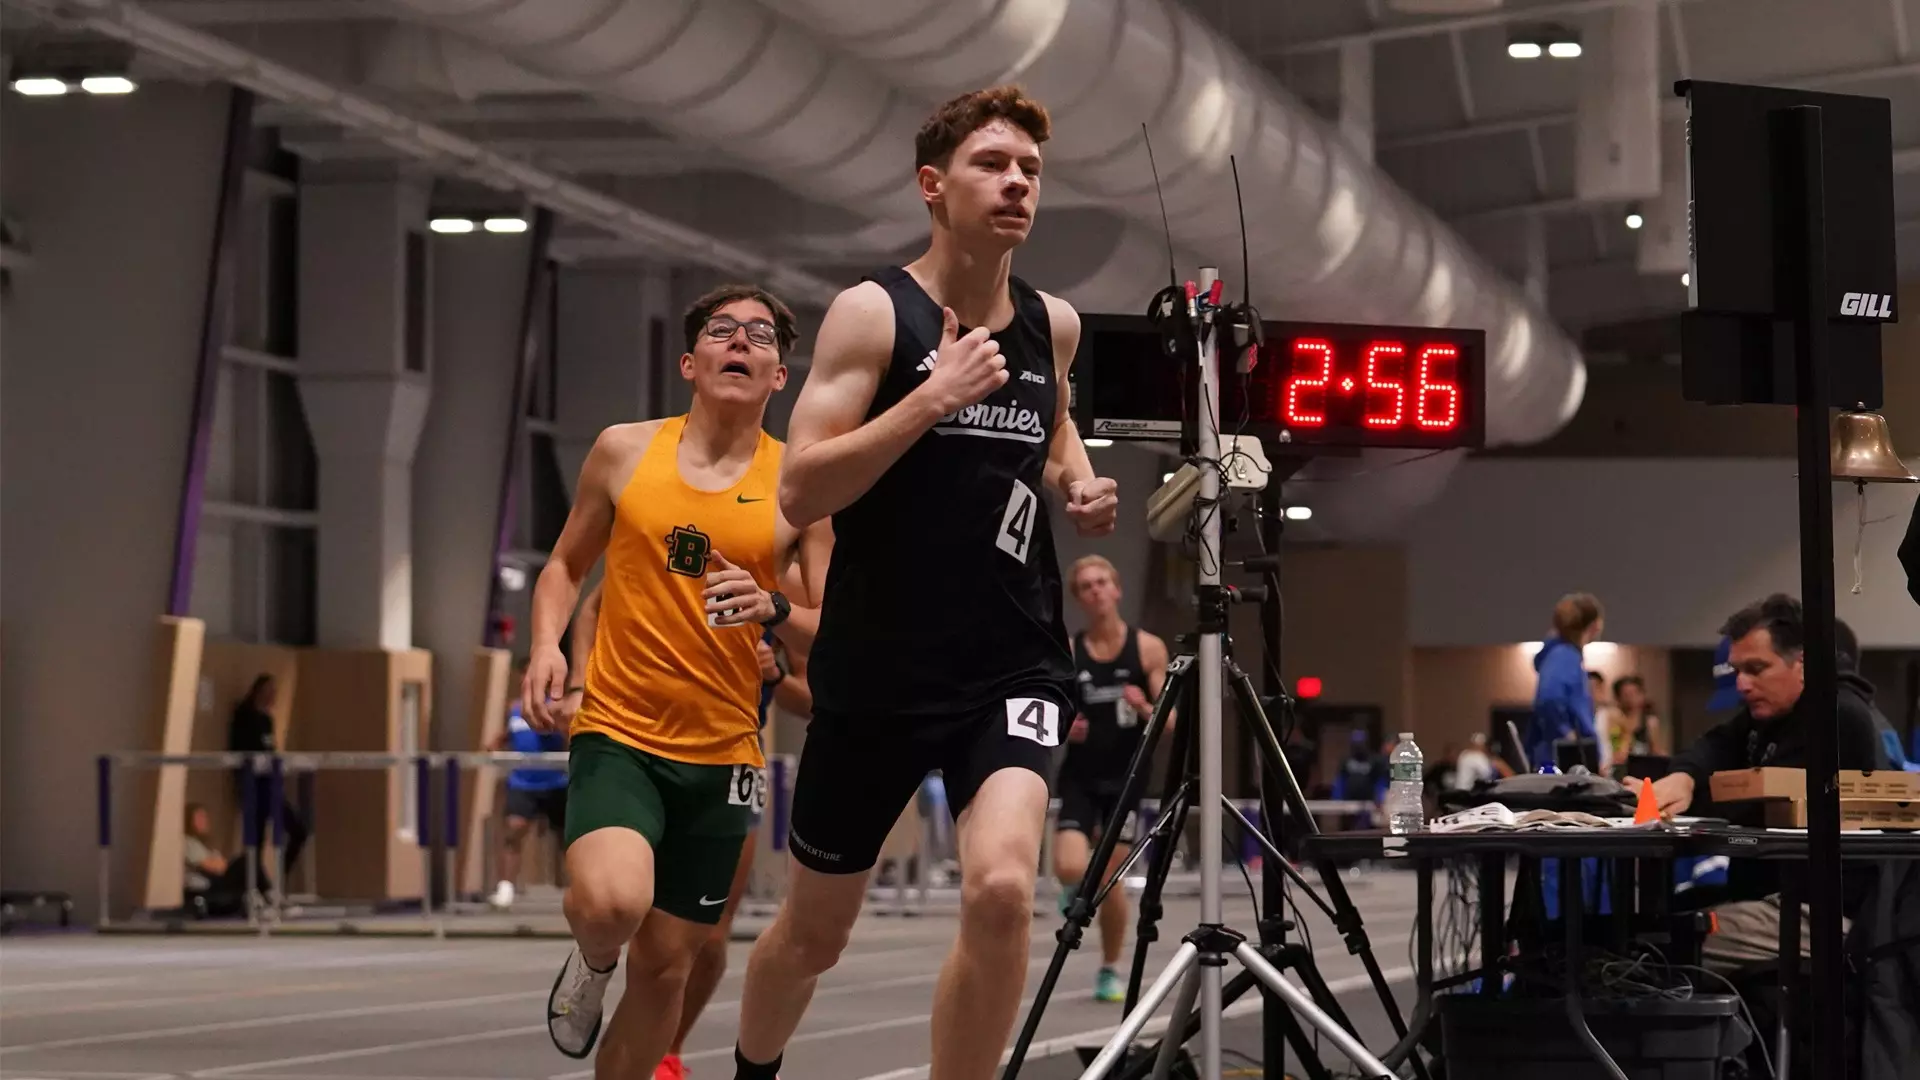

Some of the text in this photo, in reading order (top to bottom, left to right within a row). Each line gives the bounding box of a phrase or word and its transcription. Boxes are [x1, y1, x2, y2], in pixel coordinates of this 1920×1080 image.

[1840, 292, 1892, 318] GILL
[936, 400, 1045, 443] onnies
[1006, 493, 1032, 556] 4
[664, 524, 711, 578] B
[1017, 699, 1049, 743] 4
[737, 764, 754, 803] 6
